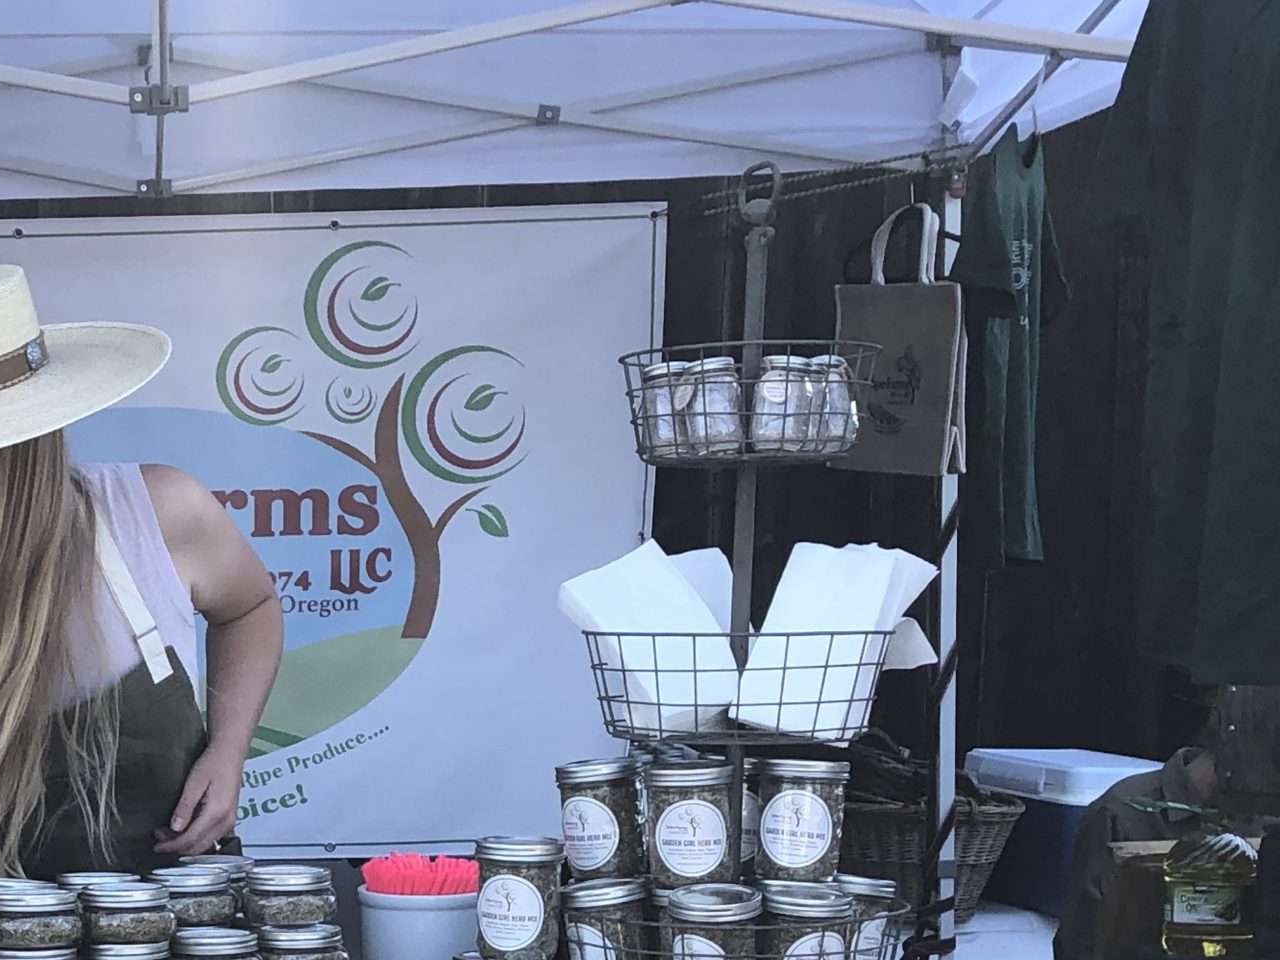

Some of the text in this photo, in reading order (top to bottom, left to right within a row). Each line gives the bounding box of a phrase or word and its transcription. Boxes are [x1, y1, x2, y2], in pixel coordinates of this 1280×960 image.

[210, 485, 380, 537] rms
[279, 594, 360, 617] Oregon
[241, 767, 283, 789] Ripe
[236, 783, 308, 821] oice!
